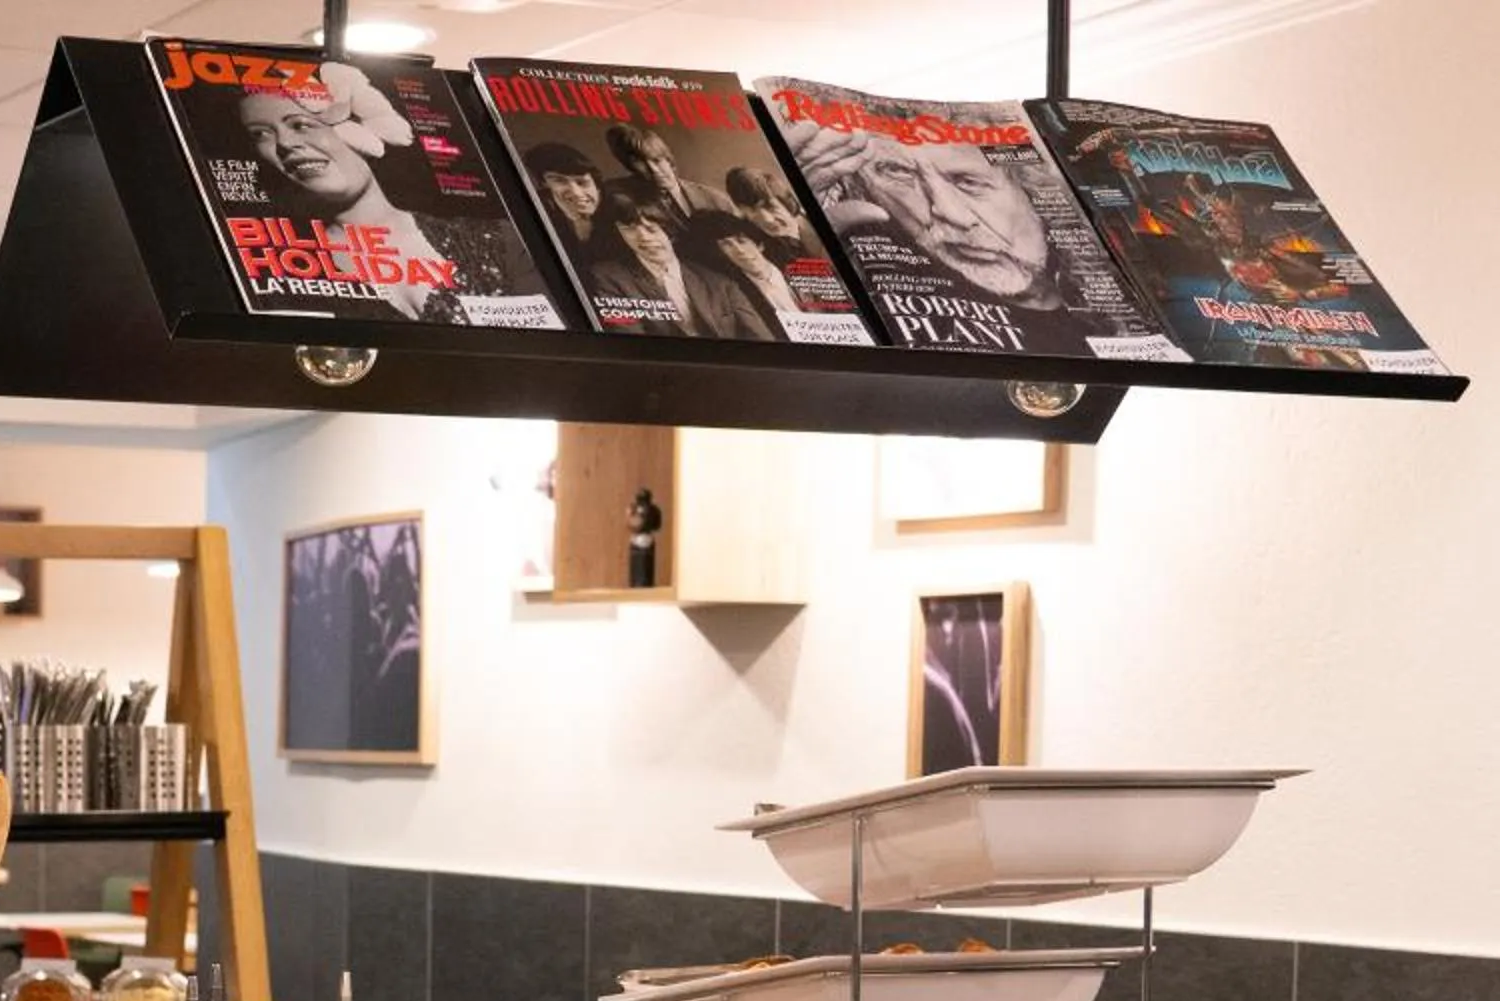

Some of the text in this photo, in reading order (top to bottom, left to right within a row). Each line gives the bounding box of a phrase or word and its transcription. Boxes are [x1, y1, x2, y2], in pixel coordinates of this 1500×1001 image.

[164, 42, 319, 90] jazz
[486, 74, 632, 122] ROLLING
[631, 87, 757, 130] STONES
[226, 217, 399, 256] BILLIE
[239, 247, 458, 289] HOLIDAY
[251, 277, 393, 300] LA REBELLE
[880, 293, 1011, 325] ROBERT
[894, 315, 1025, 350] PLANT
